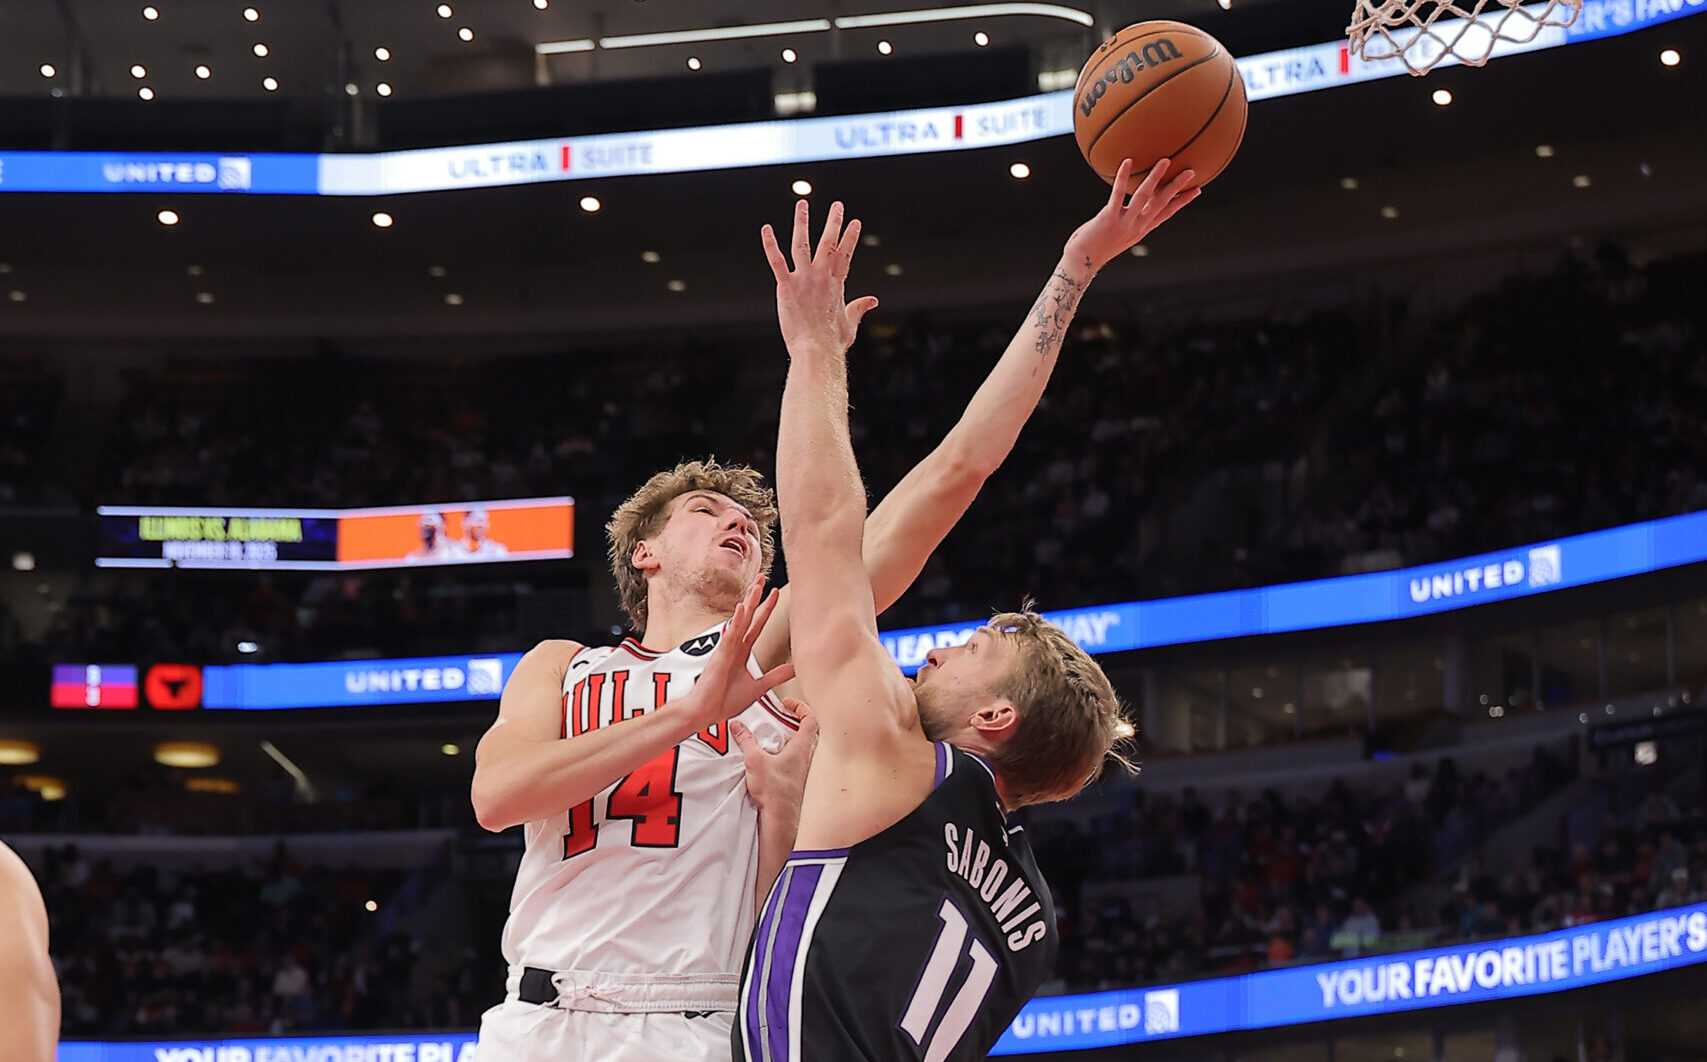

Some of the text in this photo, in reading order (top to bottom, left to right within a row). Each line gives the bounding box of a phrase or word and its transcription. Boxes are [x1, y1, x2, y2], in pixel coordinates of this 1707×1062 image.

[1080, 38, 1184, 118] Wilson
[1240, 55, 1326, 91] LTRA
[834, 107, 1047, 150] ULTRA SUITE
[103, 162, 216, 183] UNITED
[447, 142, 653, 179] ULTRA SUITE
[1410, 560, 1525, 603] UNITED
[345, 667, 465, 693] UNITED
[562, 745, 684, 861] 14
[944, 822, 1047, 952] SABONIS
[897, 892, 1000, 1062] 11
[1316, 911, 1707, 1008] YOUR FAVORITE PLAYER'S
[1012, 1003, 1141, 1040] UNITED
